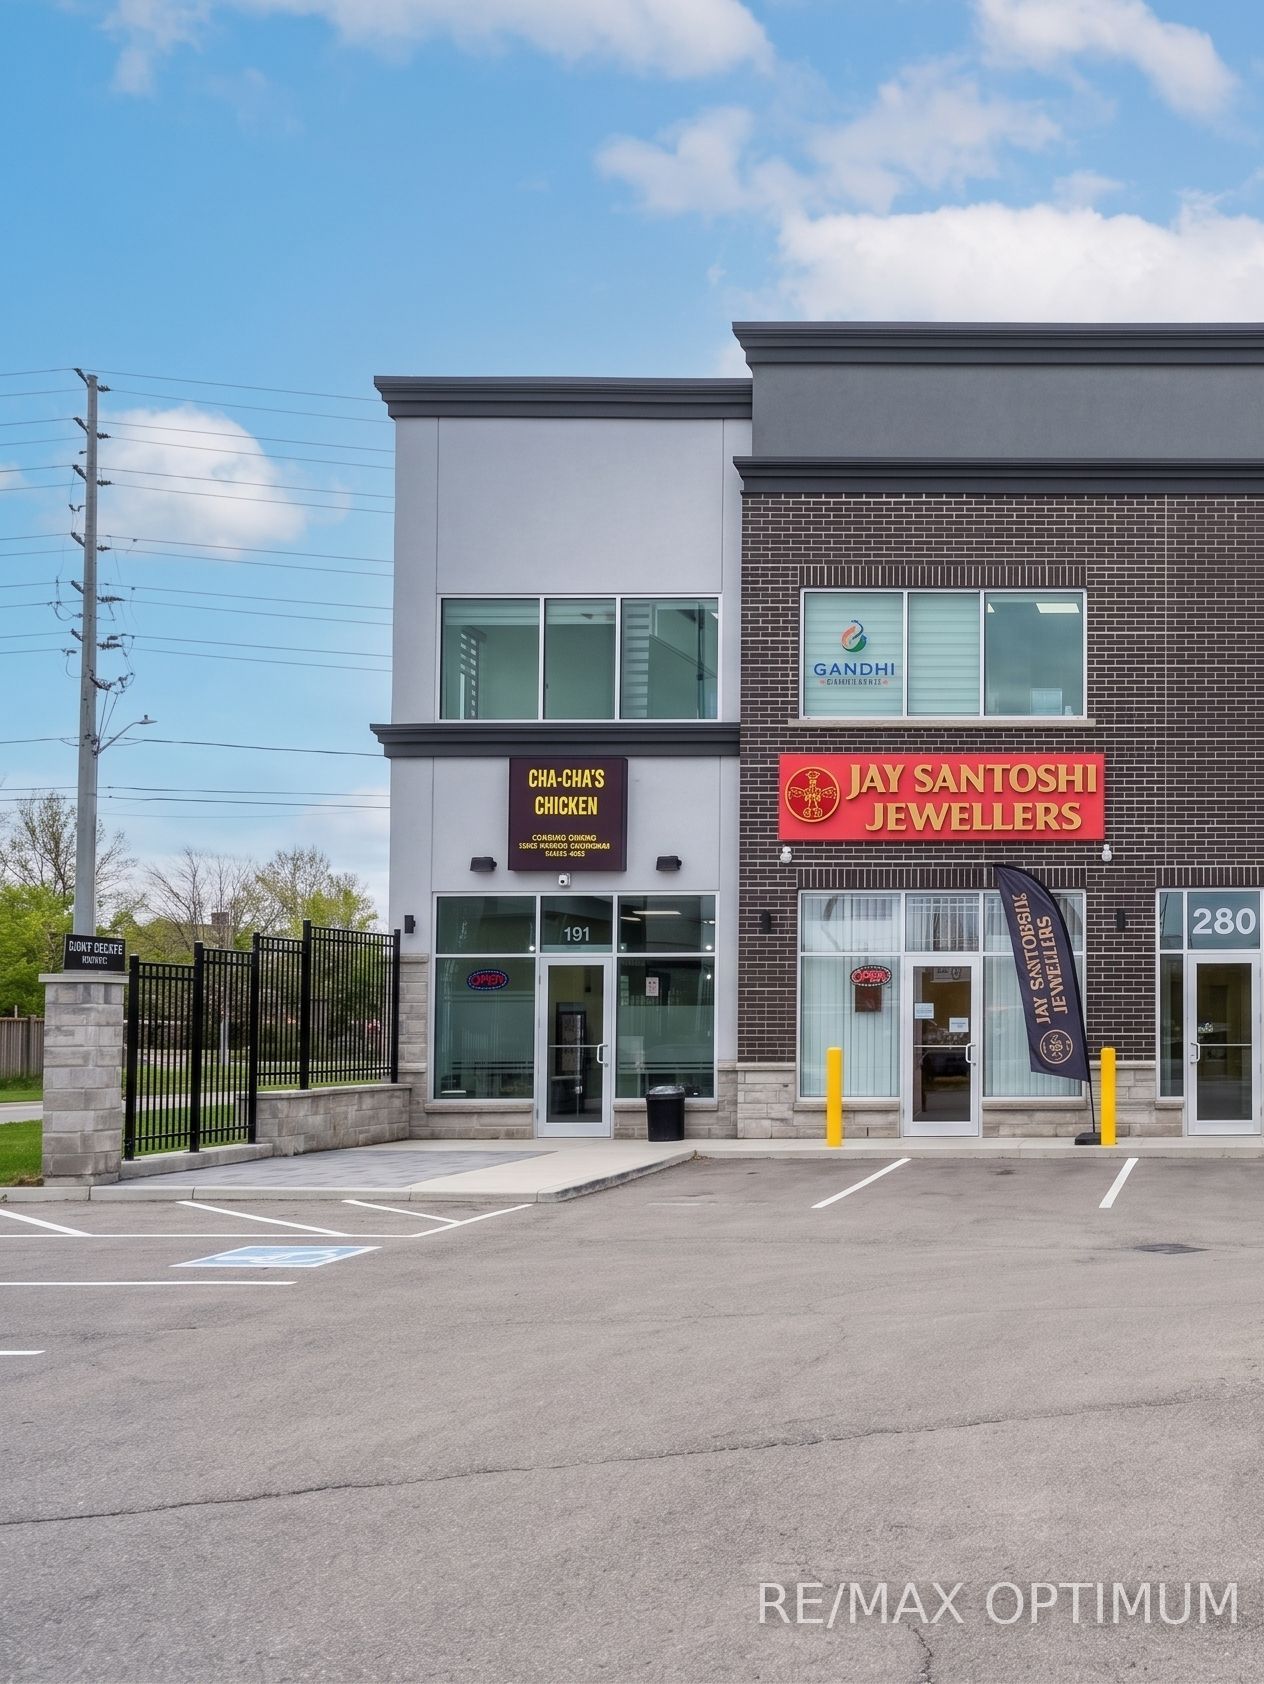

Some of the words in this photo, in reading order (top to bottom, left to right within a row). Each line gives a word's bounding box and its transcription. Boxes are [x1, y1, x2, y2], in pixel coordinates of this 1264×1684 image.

[813, 662, 895, 676] GANDHI
[528, 769, 605, 788] CHA-CHA'S
[846, 763, 905, 800] JAY
[914, 763, 1097, 793] SANTOSHI
[535, 796, 598, 815] CHICKEN
[865, 801, 1082, 831] JEWELLERS
[1192, 907, 1257, 935] 280
[564, 926, 590, 942] 191
[1033, 997, 1051, 1024] JAY
